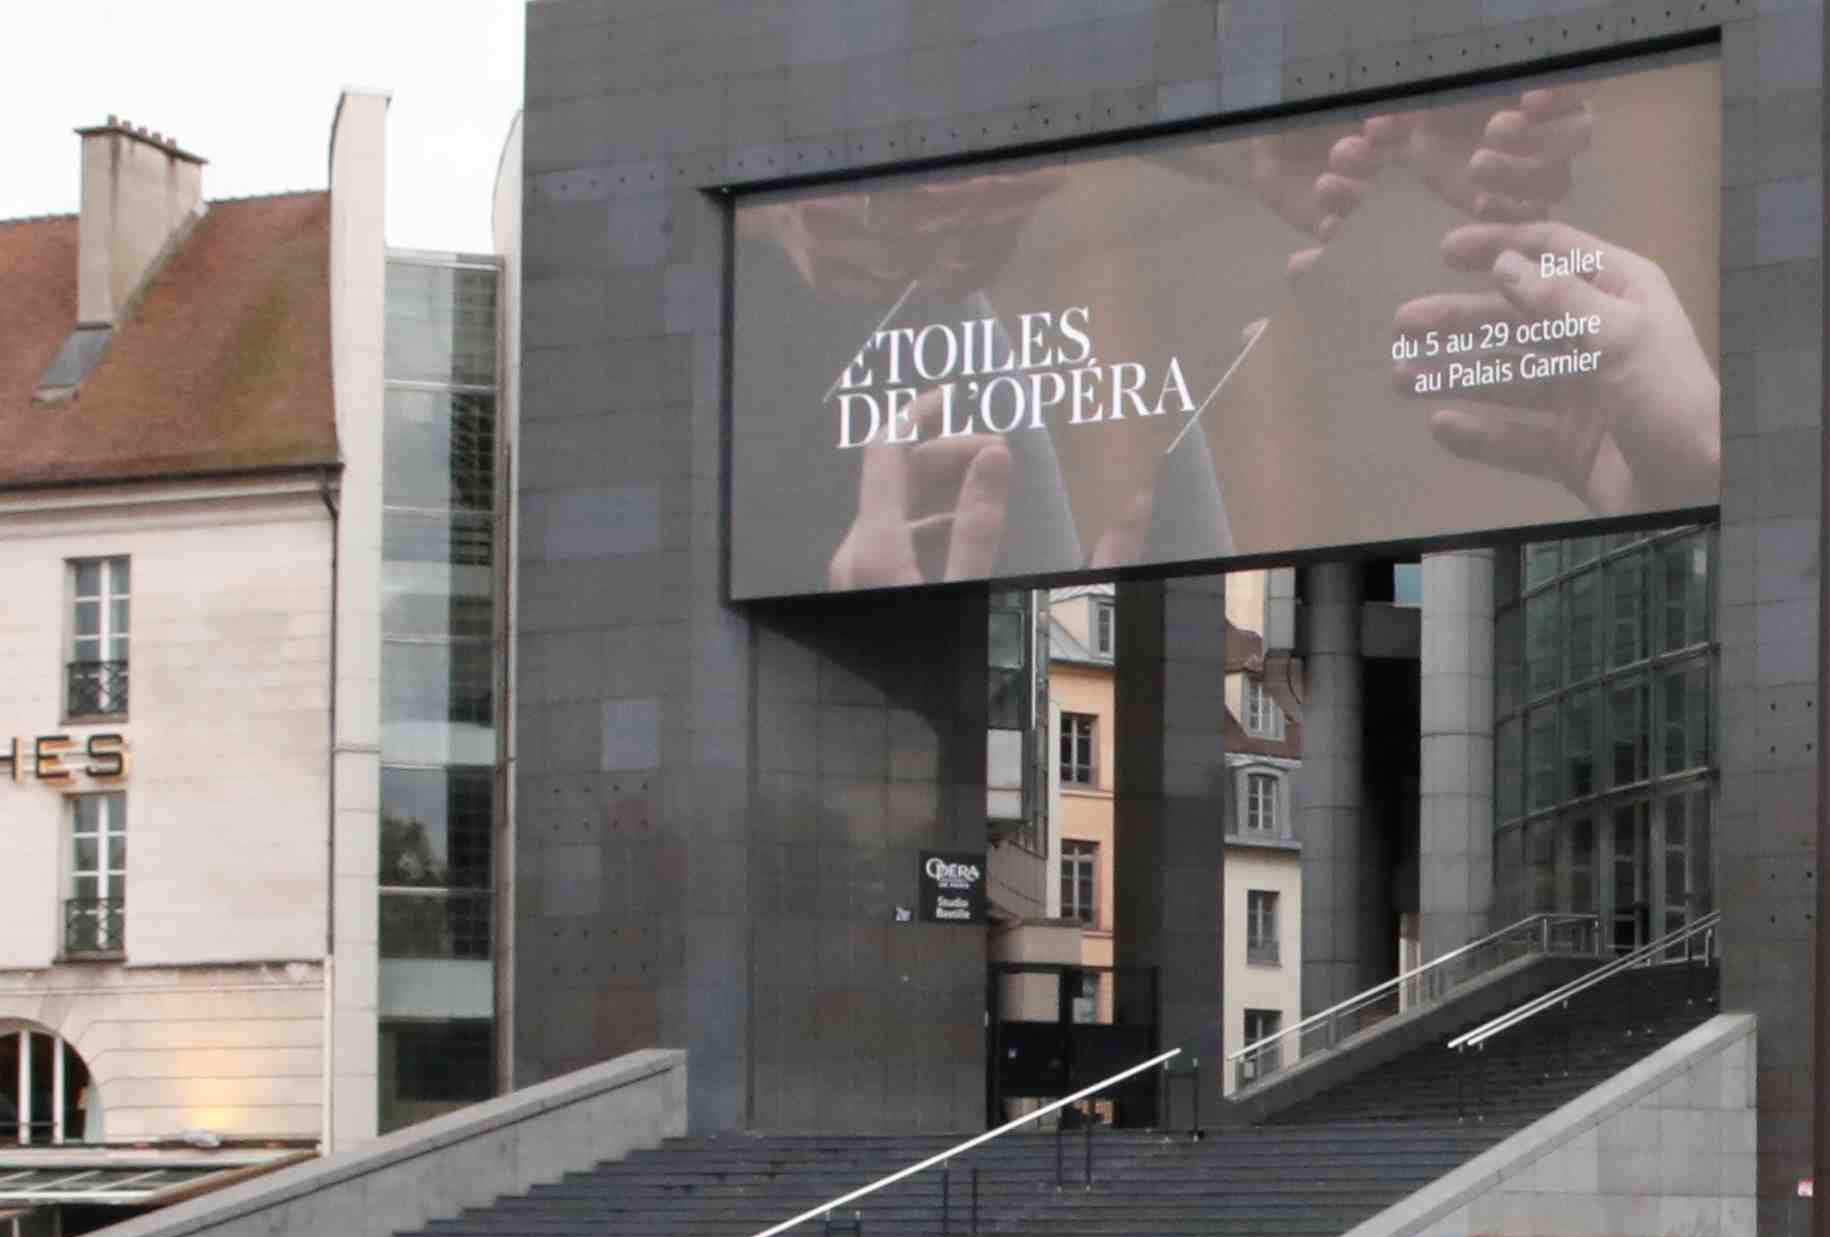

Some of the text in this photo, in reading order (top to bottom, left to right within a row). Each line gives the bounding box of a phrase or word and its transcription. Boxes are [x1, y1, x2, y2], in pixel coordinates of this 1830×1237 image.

[1540, 248, 1603, 278] Ballet
[1392, 311, 1600, 360] du 5 au 29 octobre
[1415, 348, 1601, 393] au Palais Garnier
[836, 387, 918, 449] DE
